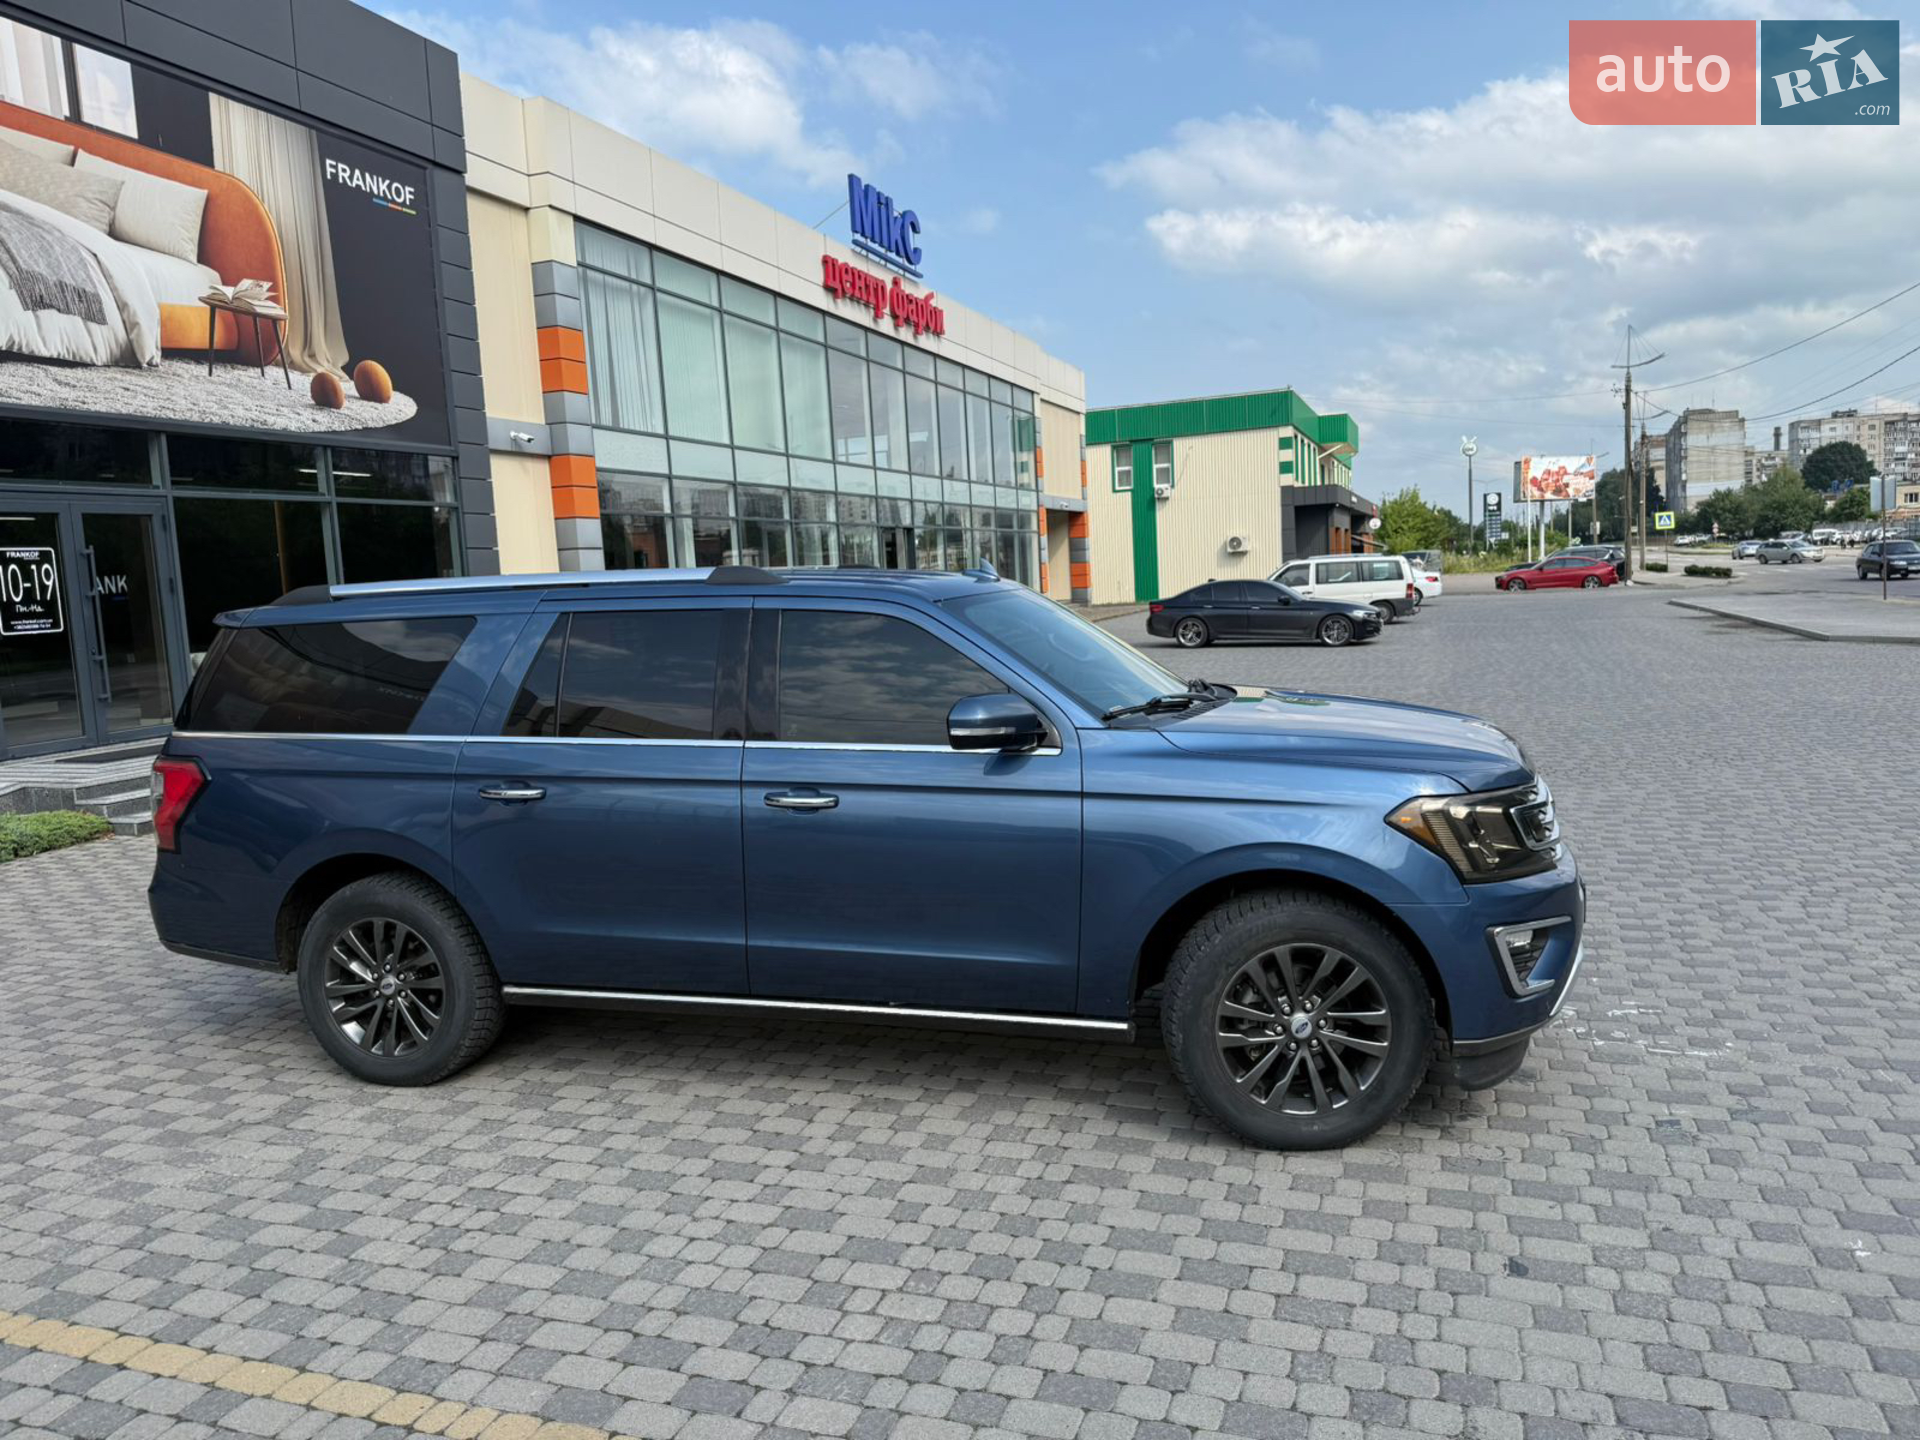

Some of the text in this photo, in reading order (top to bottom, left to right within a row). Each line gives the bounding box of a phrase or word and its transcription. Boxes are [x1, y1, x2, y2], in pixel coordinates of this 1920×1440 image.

[325, 158, 415, 205] FRANKOF
[821, 254, 946, 335] центр фарби
[0, 563, 54, 602] 10-19
